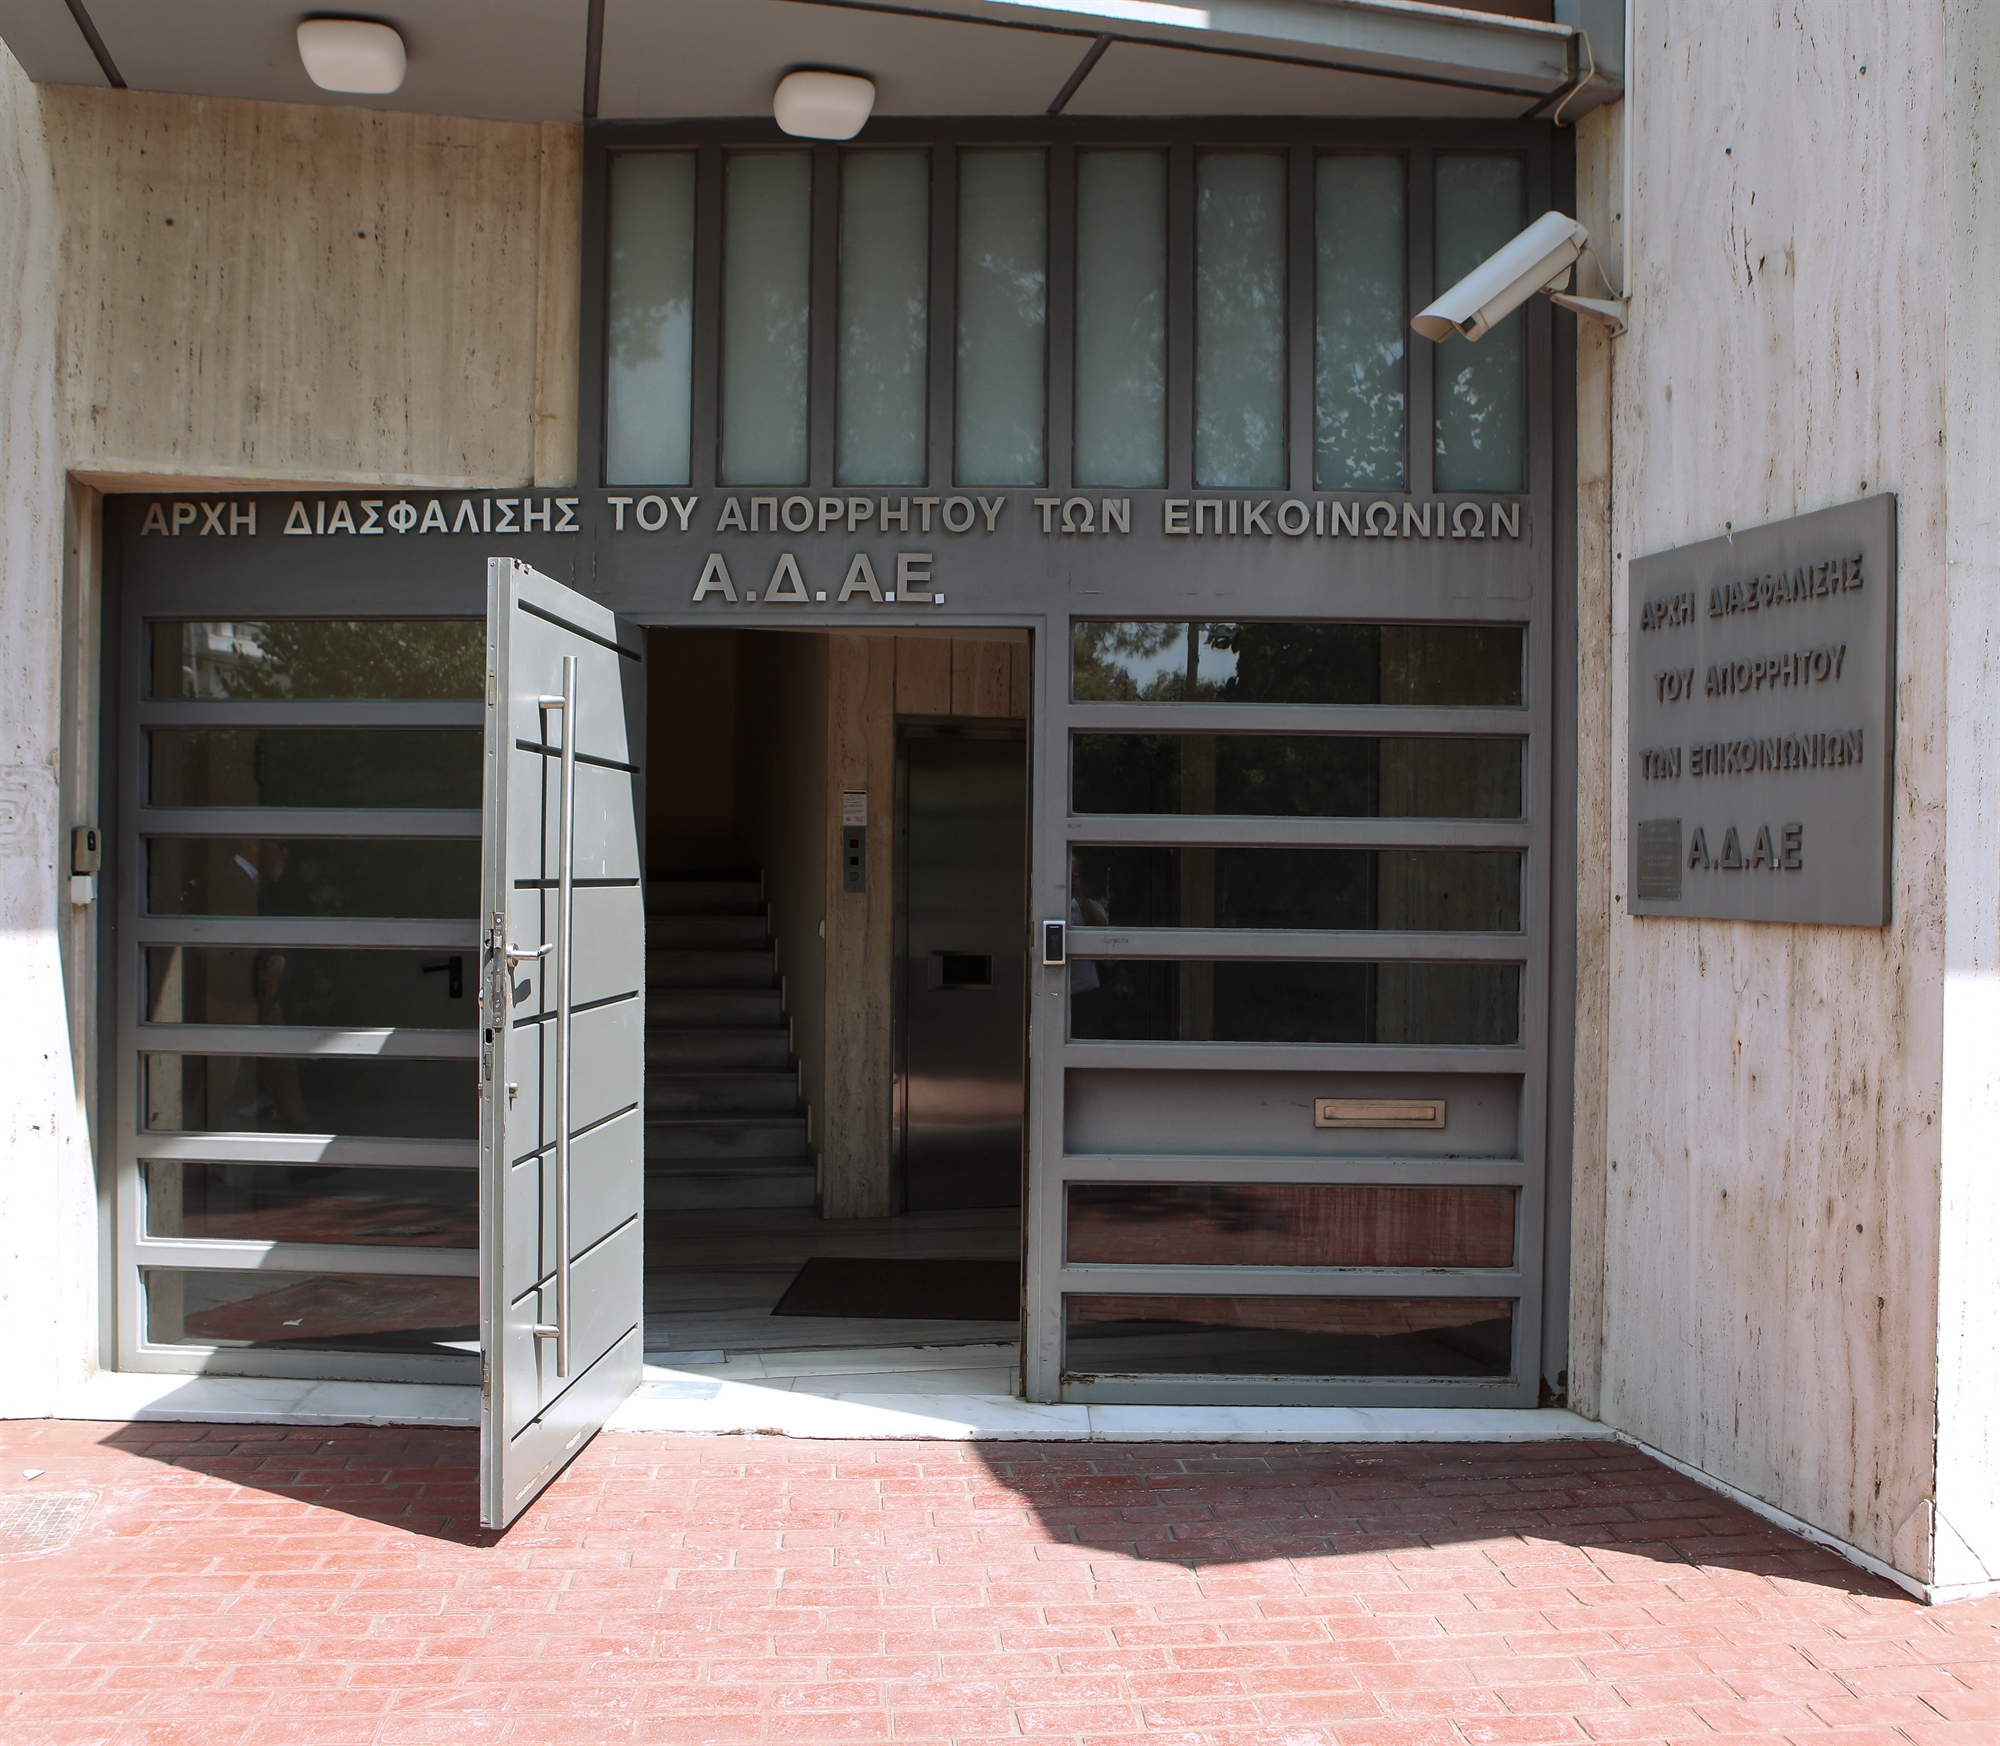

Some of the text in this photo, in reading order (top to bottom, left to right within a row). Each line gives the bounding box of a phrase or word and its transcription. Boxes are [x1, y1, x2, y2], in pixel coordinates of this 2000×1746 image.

[141, 495, 1520, 539] ΑΡΧΗ ΔΙΑΣΦΑΛΙΣΗΣ ΤΟΥ ΑΠΟΡΡΗΤΟΥ ΤΩΝ ΕΠΙΚΟΙΝΩΝΙΩΝ
[692, 553, 945, 604] Α.Δ.Α.Ε.
[1640, 553, 1864, 631] ΑΡΧΗ ΔΙΑΣΦΑΛΙΣΗΣ
[1653, 644, 1847, 702] ΤΟΥ ΑΠΟΡΡΗΤΟΥ
[1639, 729, 1863, 780] ΤΩΝ ΕΠΙΚΟΙΝΩΝΙΩΝ
[1687, 823, 1803, 870] Α.Δ.Α.Ε
